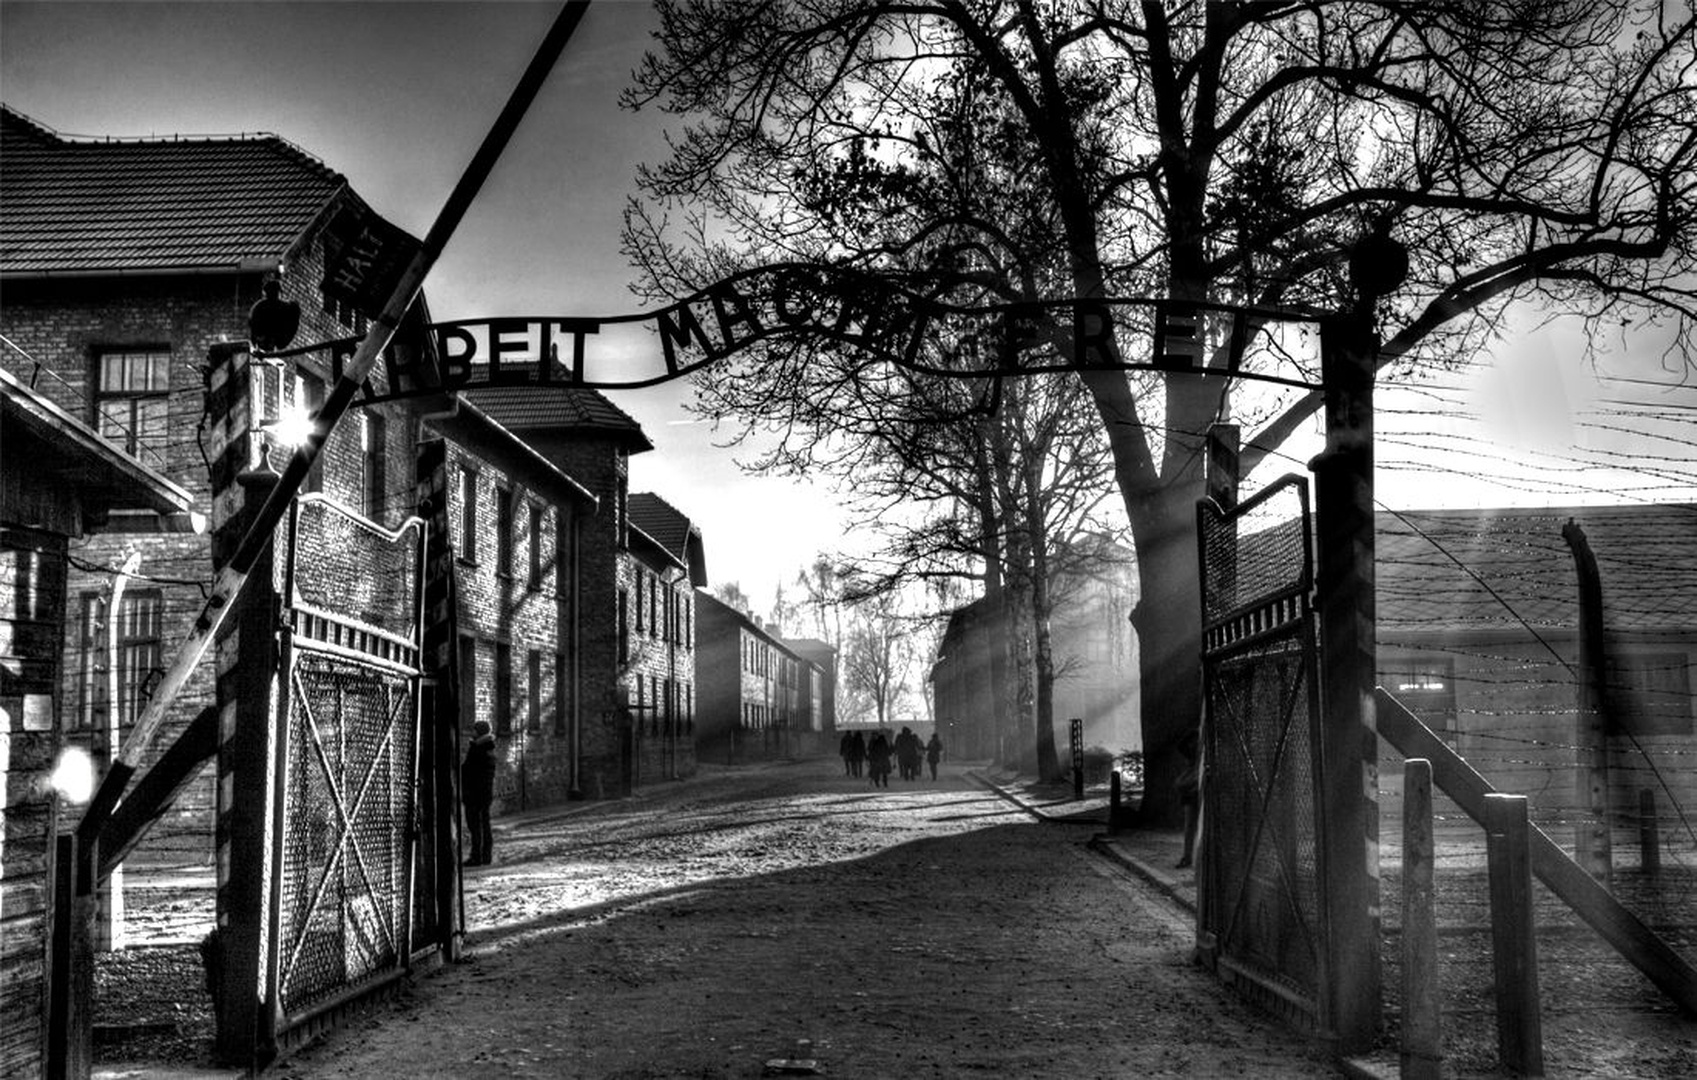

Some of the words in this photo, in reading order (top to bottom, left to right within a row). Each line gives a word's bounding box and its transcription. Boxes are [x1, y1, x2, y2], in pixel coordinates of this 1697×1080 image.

[334, 226, 383, 292] HALT
[657, 268, 932, 373] MACHT
[1003, 301, 1245, 371] FREI
